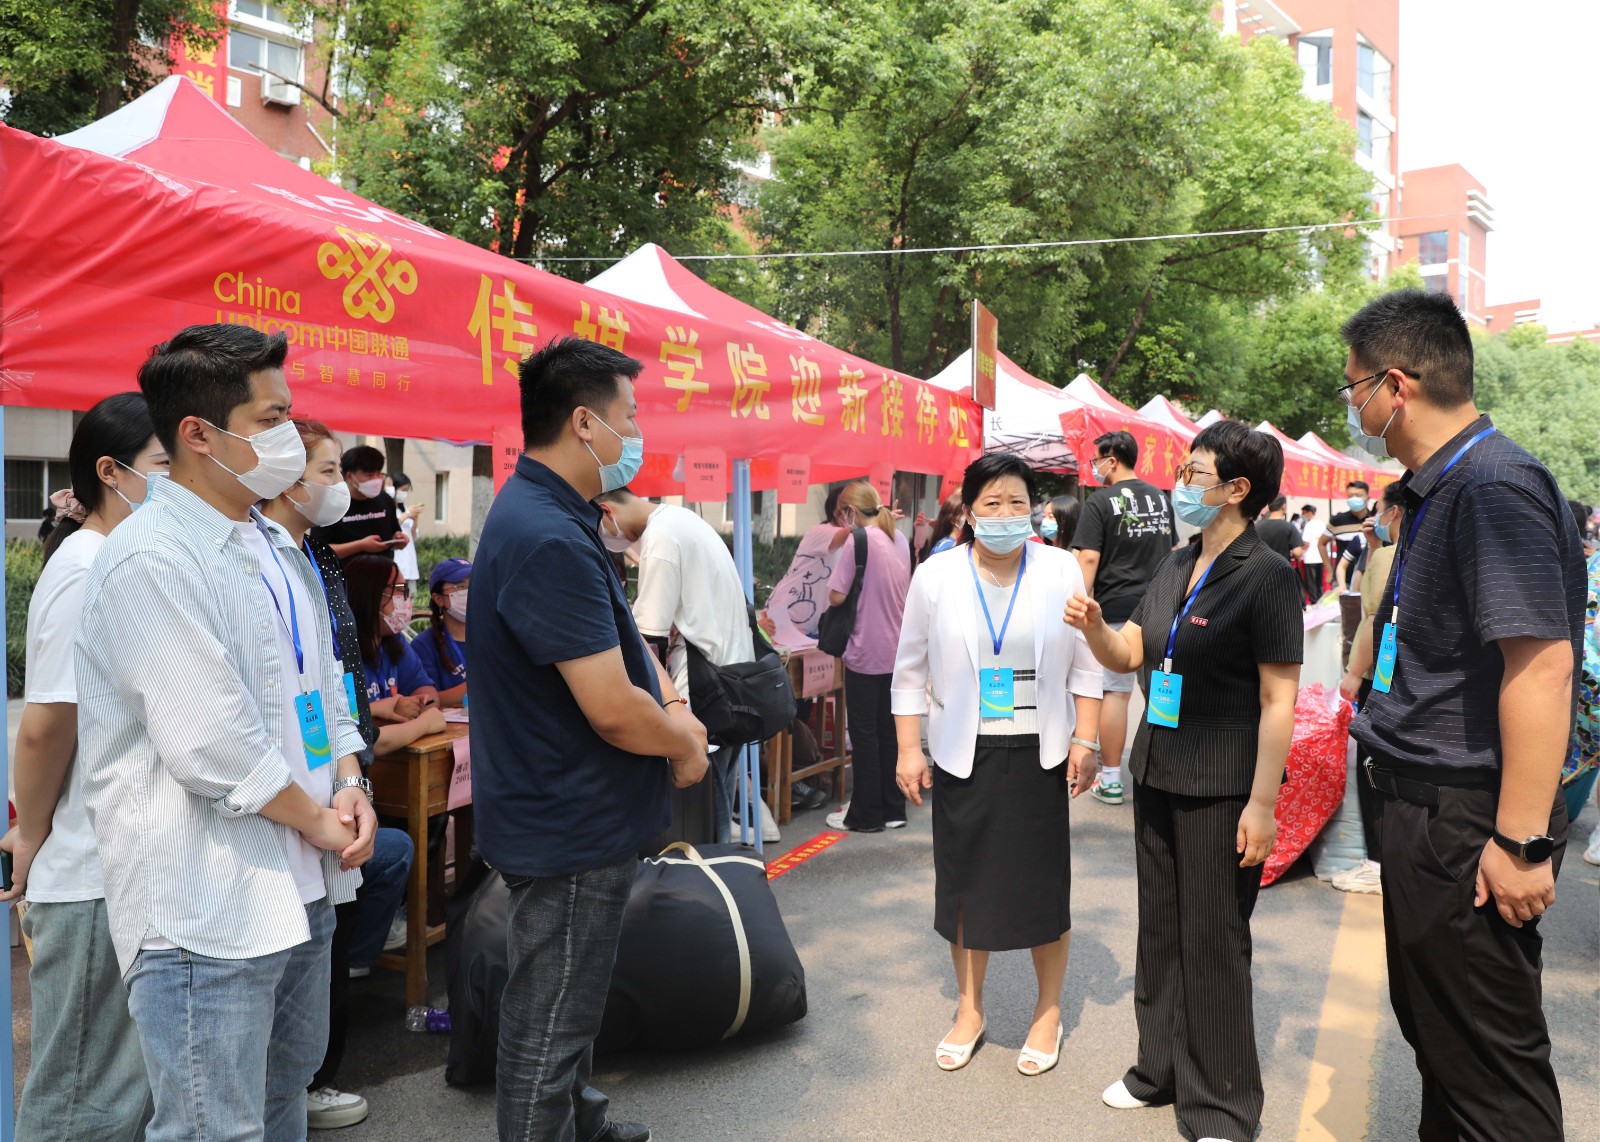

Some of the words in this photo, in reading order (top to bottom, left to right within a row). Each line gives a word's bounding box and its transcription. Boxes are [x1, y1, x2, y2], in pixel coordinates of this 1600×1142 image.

[213, 271, 300, 314] China
[326, 325, 410, 361] 中国联通
